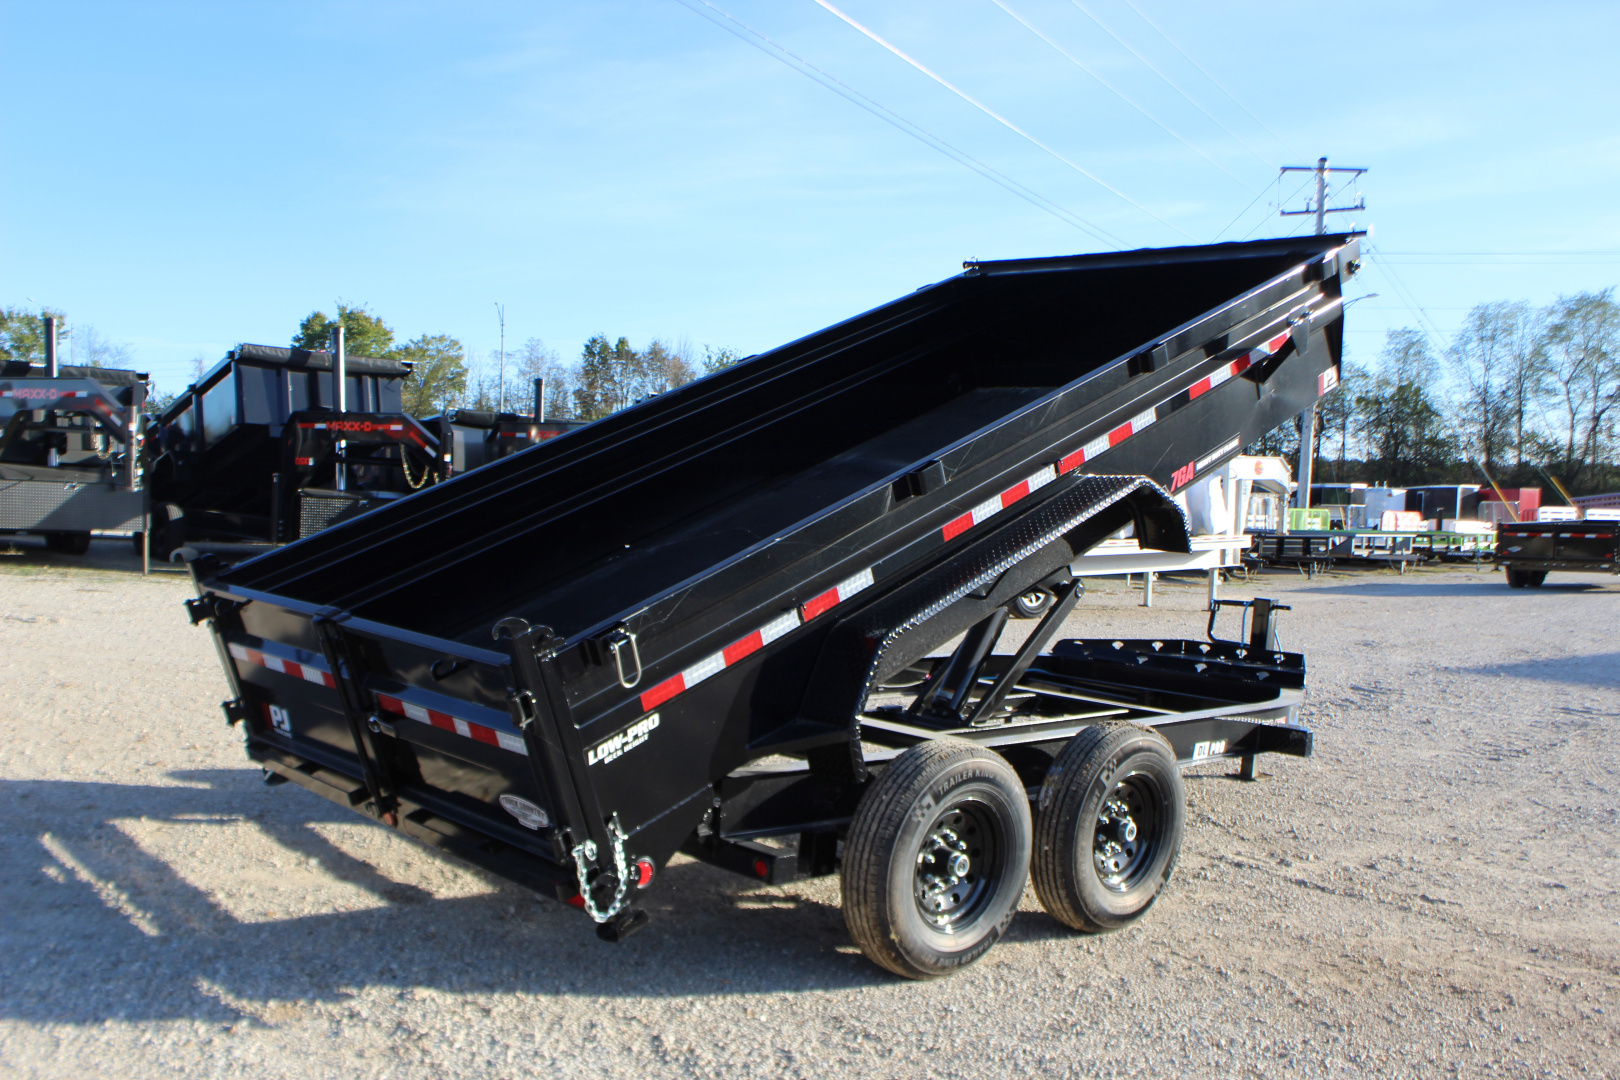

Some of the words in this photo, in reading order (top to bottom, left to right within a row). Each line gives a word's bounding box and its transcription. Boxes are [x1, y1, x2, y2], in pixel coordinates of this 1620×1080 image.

[13, 388, 57, 400] MAXX-D
[326, 421, 372, 432] MAXX-D
[1170, 460, 1195, 493] 7GA
[269, 704, 290, 732] PJ
[587, 712, 660, 766] LOW-PRO
[603, 749, 623, 765] DECK
[623, 733, 649, 753] HEIGHT
[1209, 740, 1227, 755] PRO
[938, 769, 974, 796] TRAILER
[975, 769, 995, 779] KING
